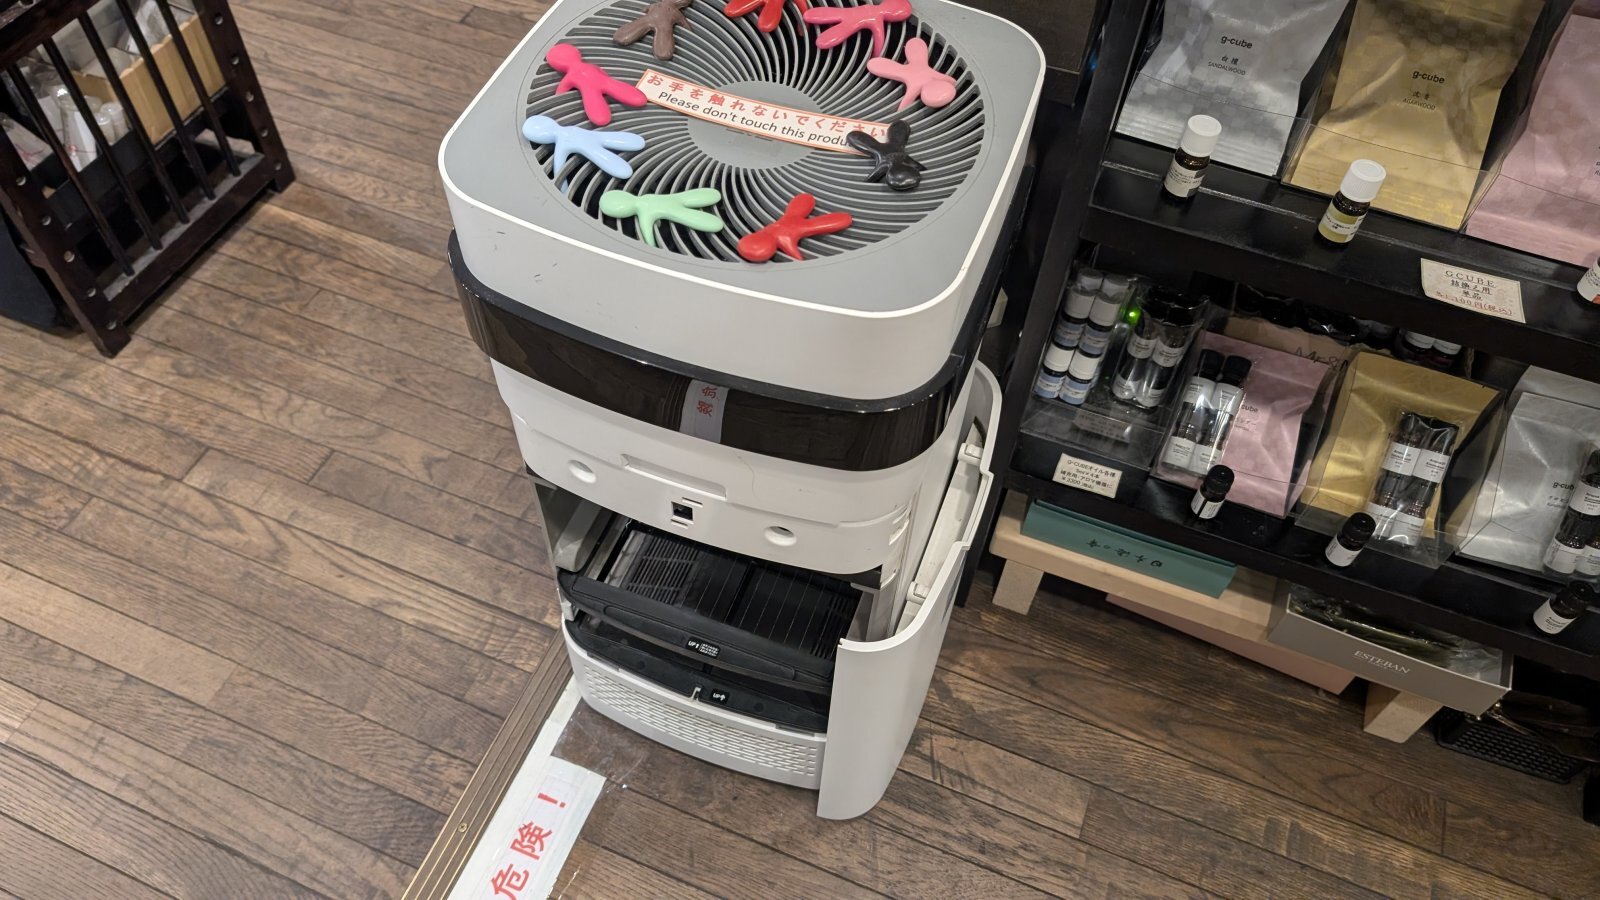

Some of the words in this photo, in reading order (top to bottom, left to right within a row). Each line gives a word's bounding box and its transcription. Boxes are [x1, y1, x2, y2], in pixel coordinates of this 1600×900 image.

[1220, 35, 1253, 49] g-cube
[1208, 61, 1246, 75] SANDALWOOD
[1412, 70, 1445, 84] g-cube
[658, 91, 700, 112] Please
[702, 106, 737, 122] don't
[740, 116, 777, 132] touch
[781, 126, 805, 138] this
[808, 132, 852, 147] produ
[1241, 404, 1258, 412] cube
[1552, 482, 1575, 491] g-cub
[1354, 650, 1410, 674] ESTEBAN
